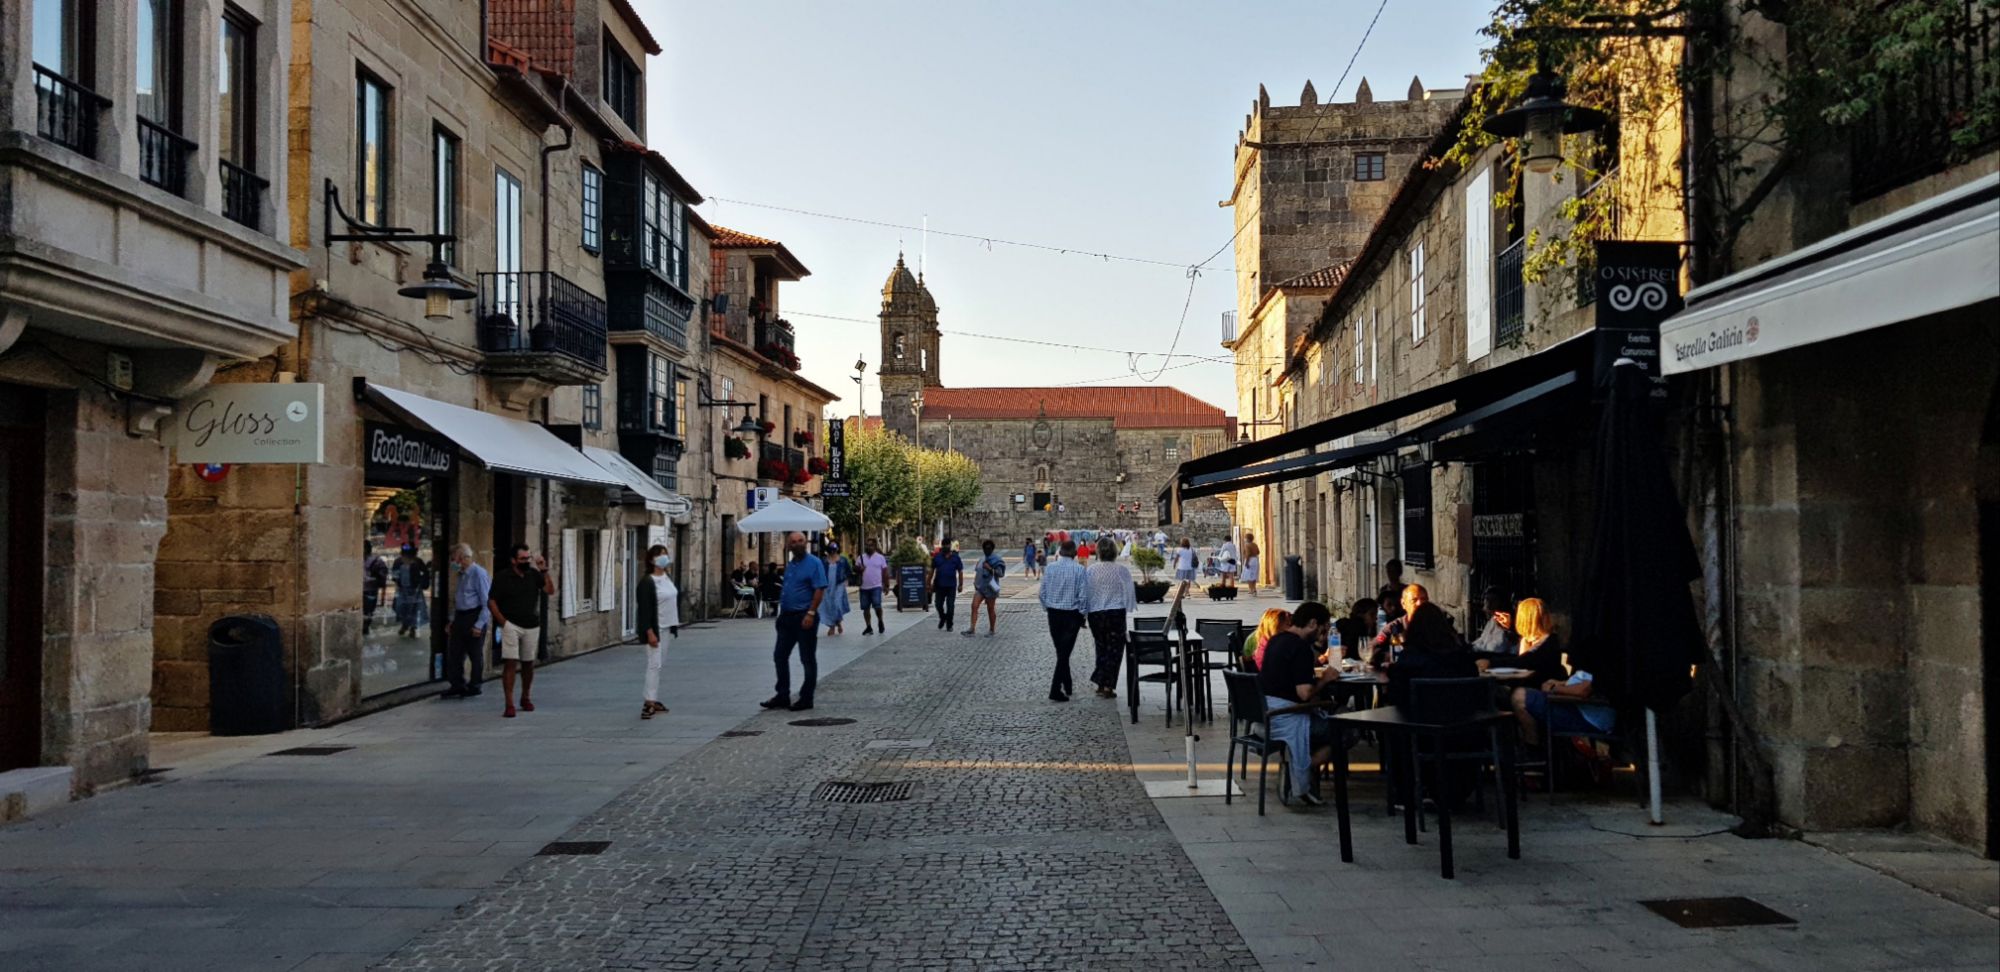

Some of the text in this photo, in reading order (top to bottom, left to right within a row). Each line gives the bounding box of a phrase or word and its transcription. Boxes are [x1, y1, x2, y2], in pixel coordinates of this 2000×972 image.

[1601, 266, 1615, 280] O
[1675, 325, 1743, 361] Estrella Galicia
[186, 399, 279, 447] Gloss
[254, 438, 300, 446] Collection
[371, 428, 403, 465] Foot
[402, 440, 420, 468] on
